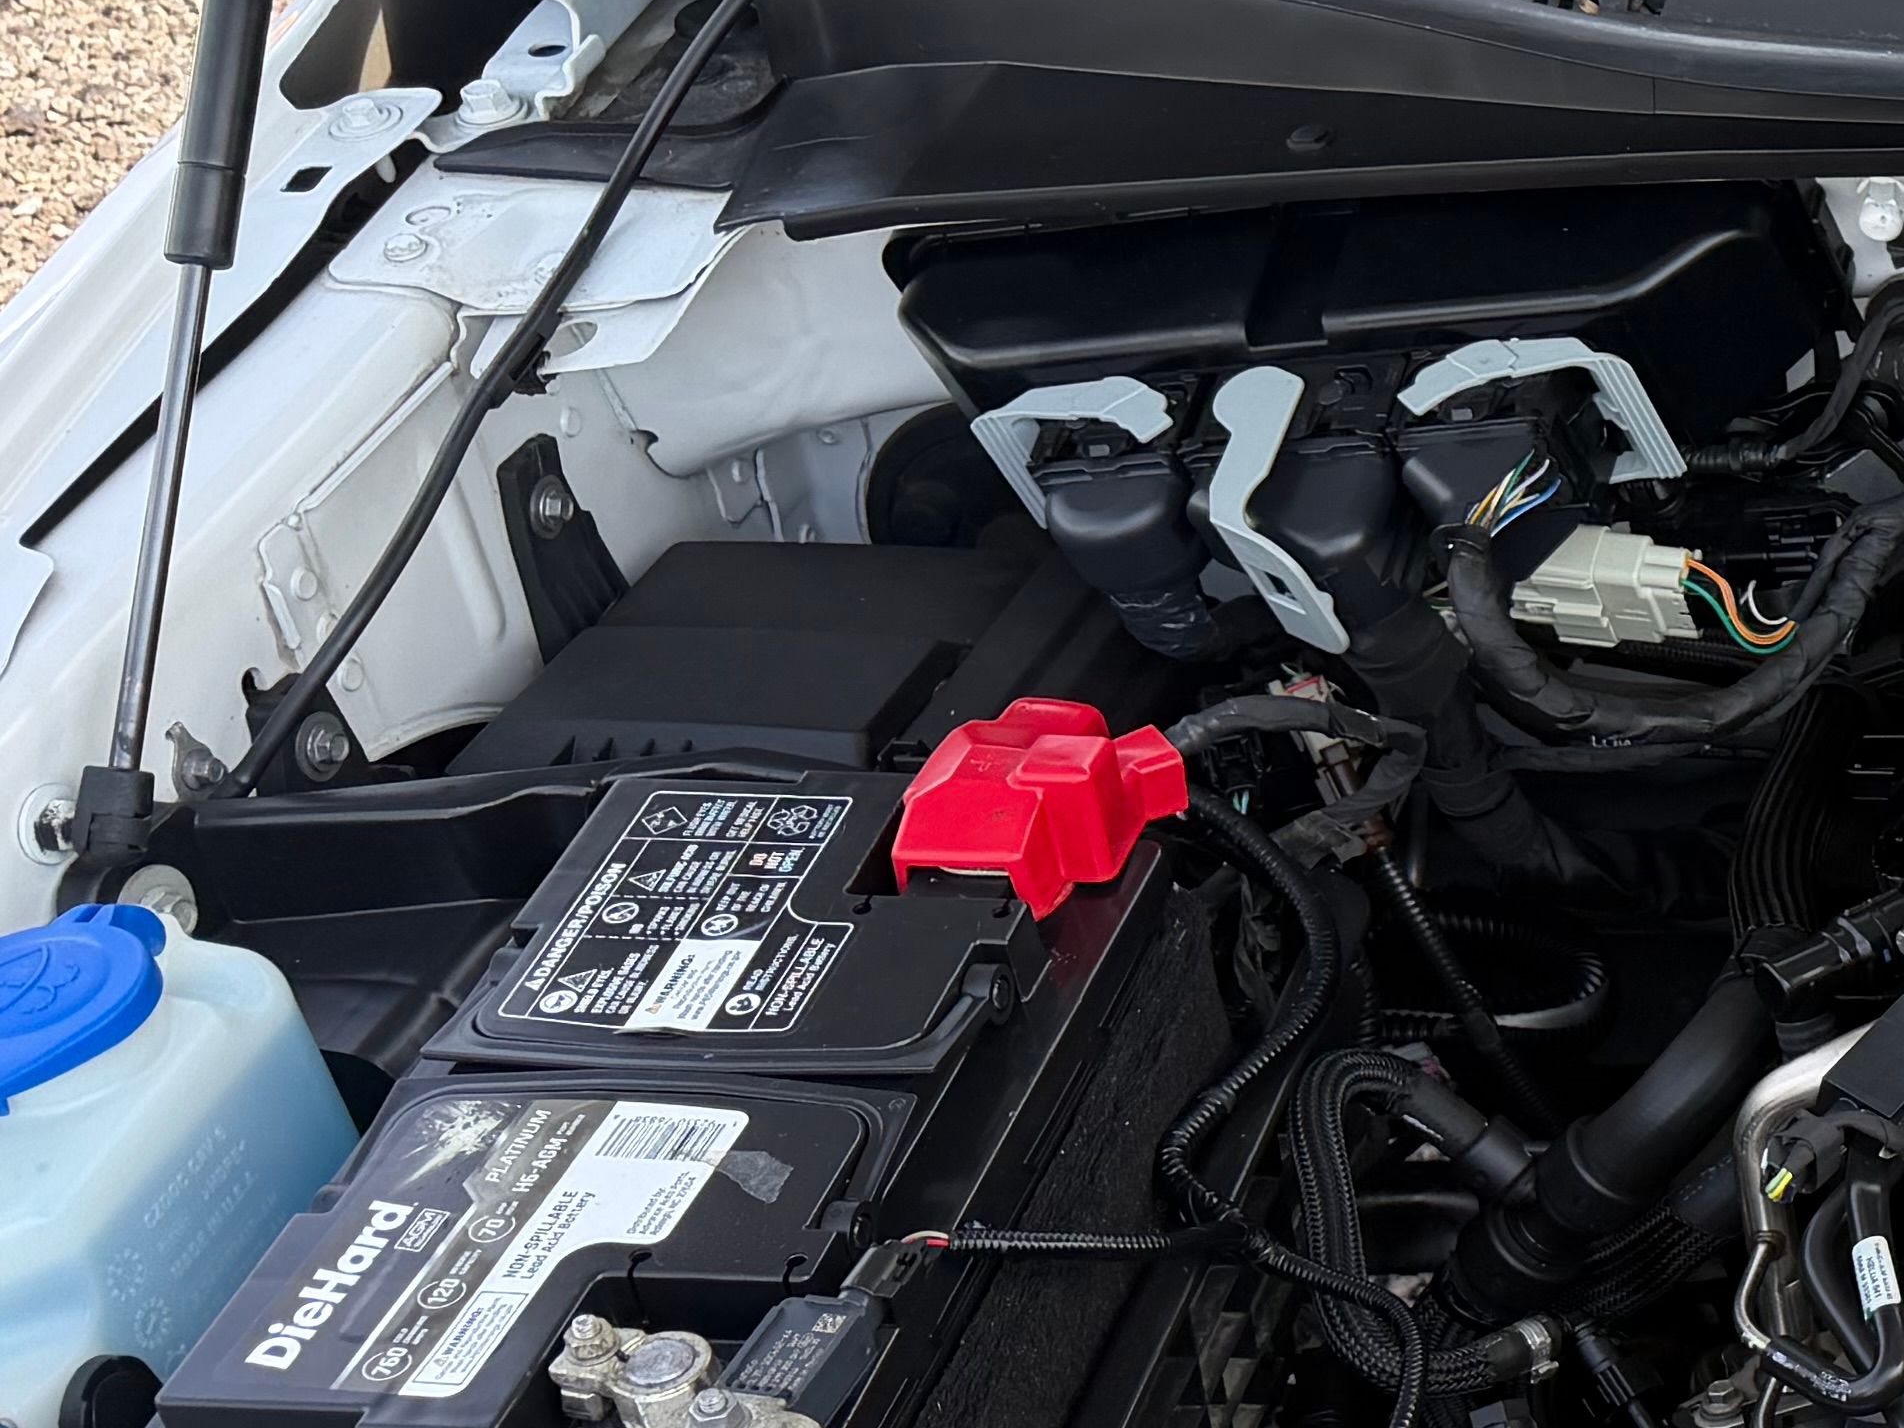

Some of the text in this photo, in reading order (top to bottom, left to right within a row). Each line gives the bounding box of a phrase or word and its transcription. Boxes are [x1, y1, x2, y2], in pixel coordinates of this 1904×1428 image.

[763, 851, 784, 868] NOT
[534, 863, 624, 976] DANGER/POISON
[765, 938, 824, 1015] NON-SPILLABLE
[485, 1109, 550, 1182] PLATINUM
[511, 1137, 566, 1192] H6-AGM
[396, 1211, 435, 1247] AGM
[477, 1218, 505, 1236] 70
[503, 1191, 577, 1277] NON-SPILLABLE
[248, 1203, 410, 1367] DieHard
[427, 1277, 460, 1303] 120
[370, 1346, 407, 1375] 760
